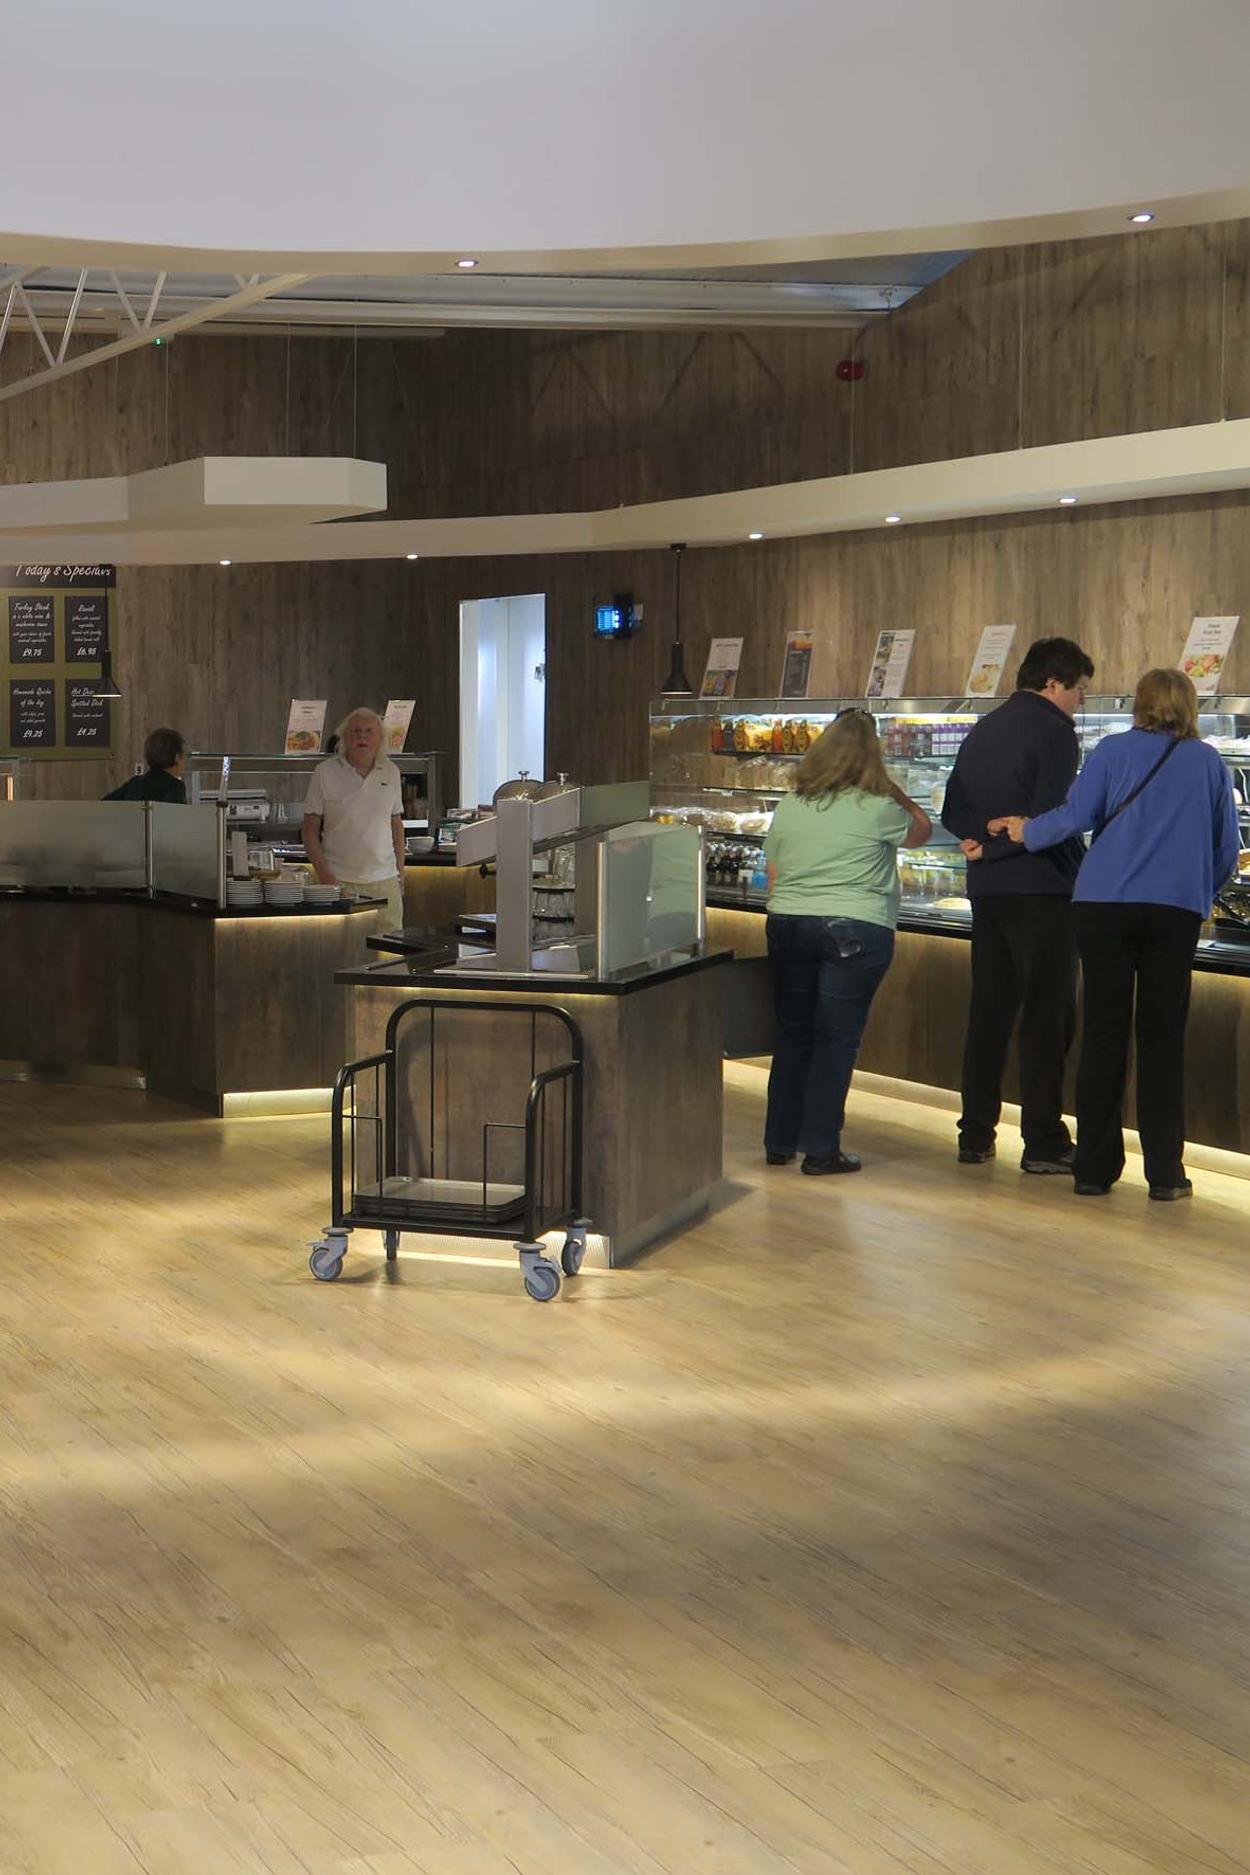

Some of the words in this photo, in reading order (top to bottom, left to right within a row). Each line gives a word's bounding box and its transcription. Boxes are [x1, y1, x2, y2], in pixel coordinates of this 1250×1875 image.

[15, 564, 62, 583] Todays
[22, 647, 42, 657] £9.75
[76, 647, 97, 656] £6.95
[23, 729, 43, 738] £9.25
[77, 726, 97, 736] £4.25
